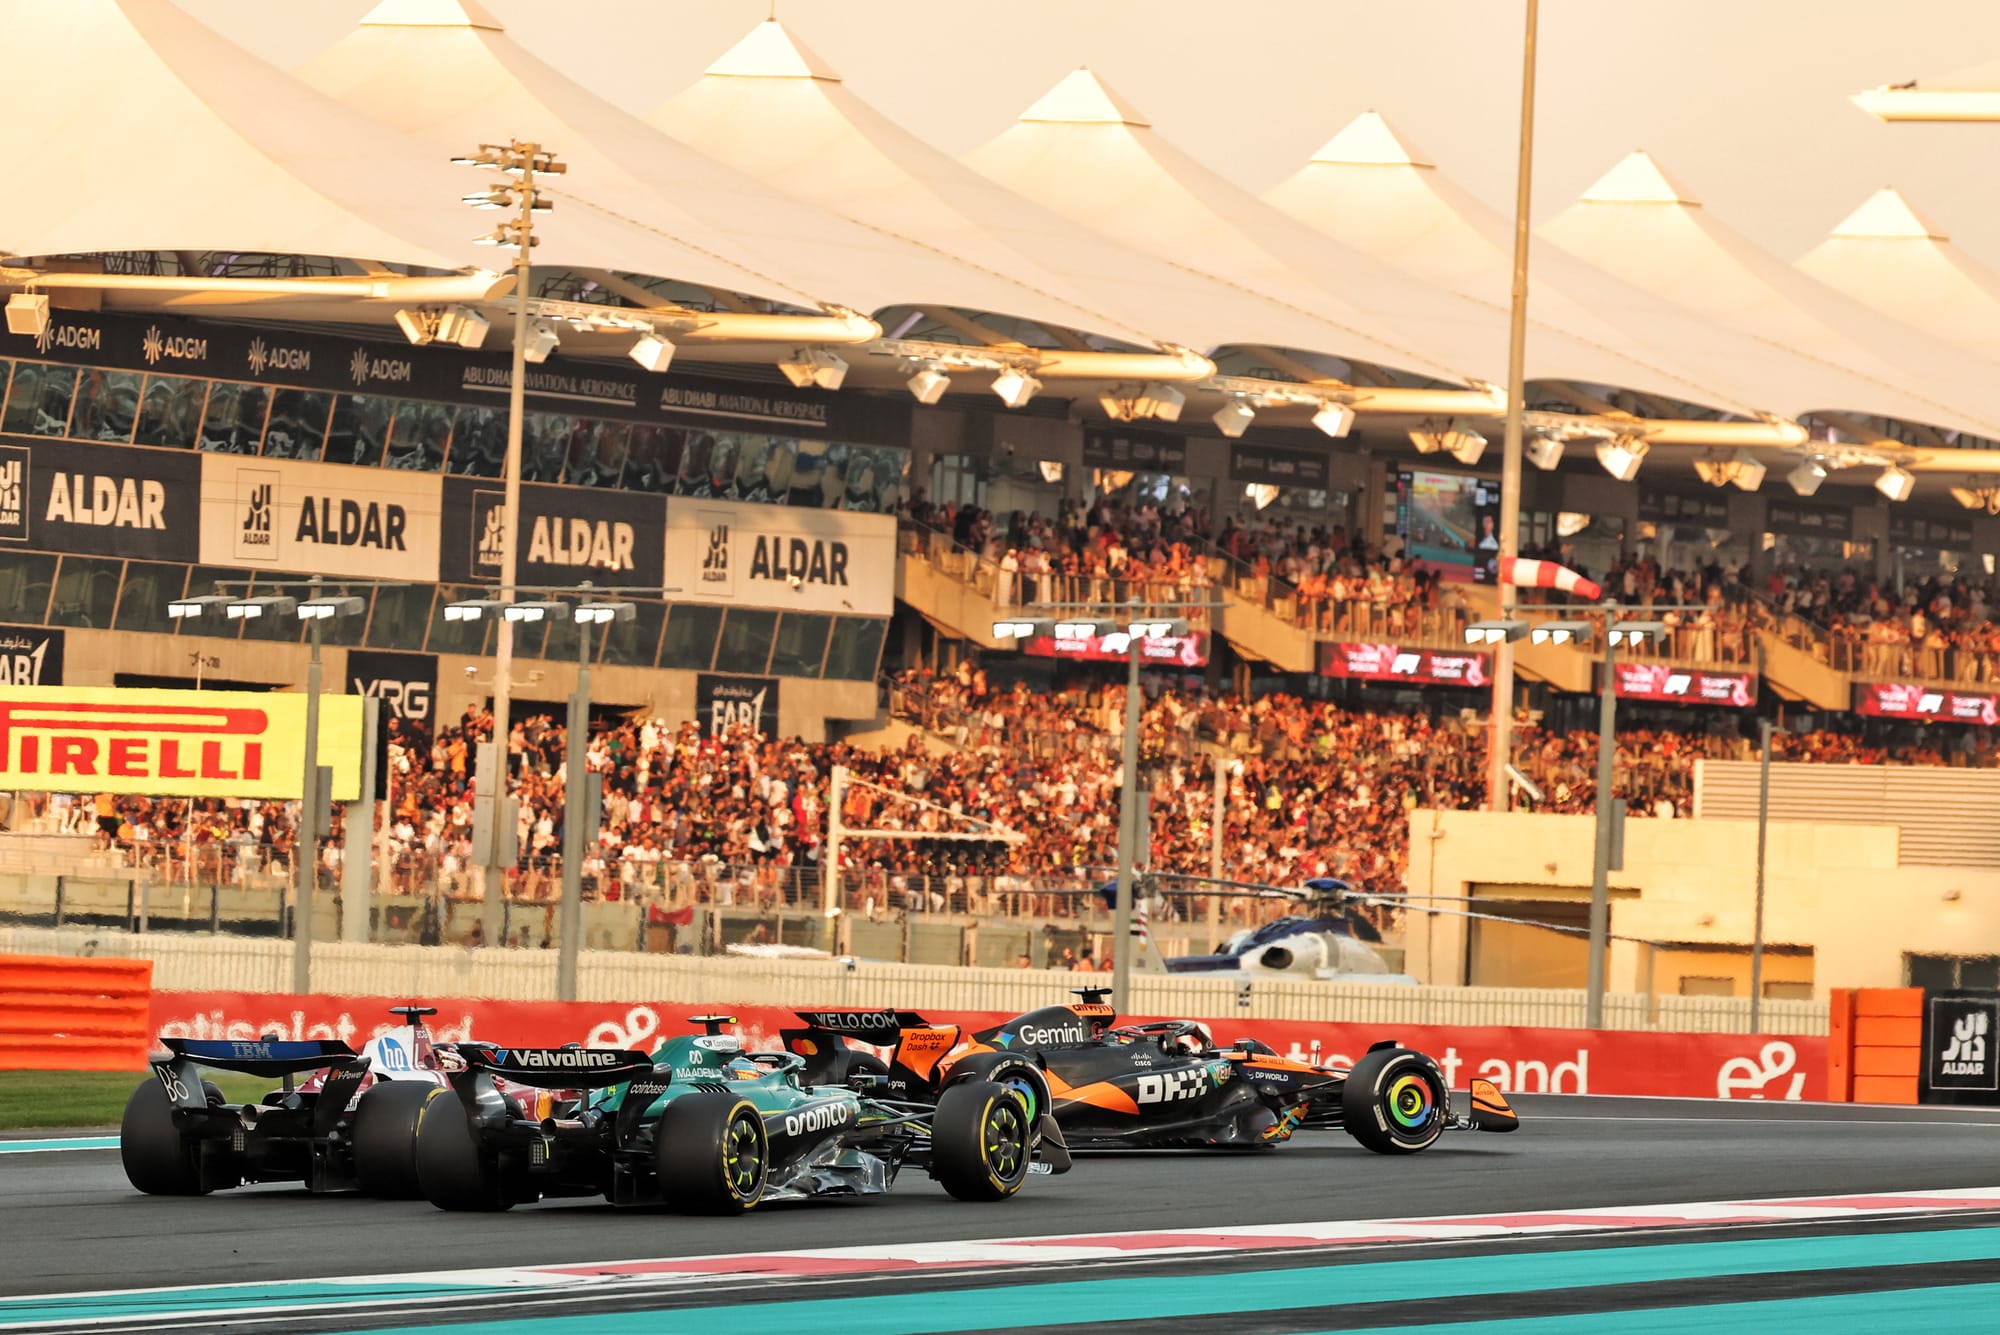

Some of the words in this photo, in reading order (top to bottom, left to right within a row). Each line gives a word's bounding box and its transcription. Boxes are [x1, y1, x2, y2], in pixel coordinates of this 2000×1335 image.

[55, 325, 101, 350] ADGM
[163, 336, 207, 360] ADGM
[268, 347, 312, 371] ADGM
[370, 358, 412, 382] ADGM
[463, 366, 486, 383] ABU
[487, 368, 514, 386] DHA
[523, 371, 569, 391] AVIATION
[580, 379, 637, 400] AEROSPACE
[661, 387, 683, 404] ABU
[684, 389, 717, 409] DHABI
[772, 400, 827, 420] AEROSPACE
[46, 471, 167, 530] ALDAR
[0, 510, 20, 525] DAR
[296, 495, 407, 551] ALDAR
[242, 532, 271, 545] ALDAR
[528, 515, 635, 570] ALDAR
[750, 534, 849, 586] ALDAR
[0, 702, 268, 780] PIRELLI
[815, 1013, 900, 1029] VELO.COM
[1020, 1021, 1085, 1045] Gemini
[907, 1043, 928, 1051] Dash
[910, 1032, 945, 1042] Dropbox
[231, 1042, 272, 1059] IBM
[383, 1038, 406, 1072] hp
[512, 1049, 617, 1067] Valvoline
[338, 1070, 363, 1080] V-Power
[675, 1066, 715, 1079] MAADEN
[1255, 1071, 1265, 1079] DP
[1265, 1073, 1289, 1082] WORLD
[1478, 1049, 1588, 1094] and
[1941, 1061, 1984, 1075] ALDAR
[630, 1080, 667, 1095] coinbase
[890, 1080, 906, 1091] groq
[785, 1101, 848, 1137] aramco
